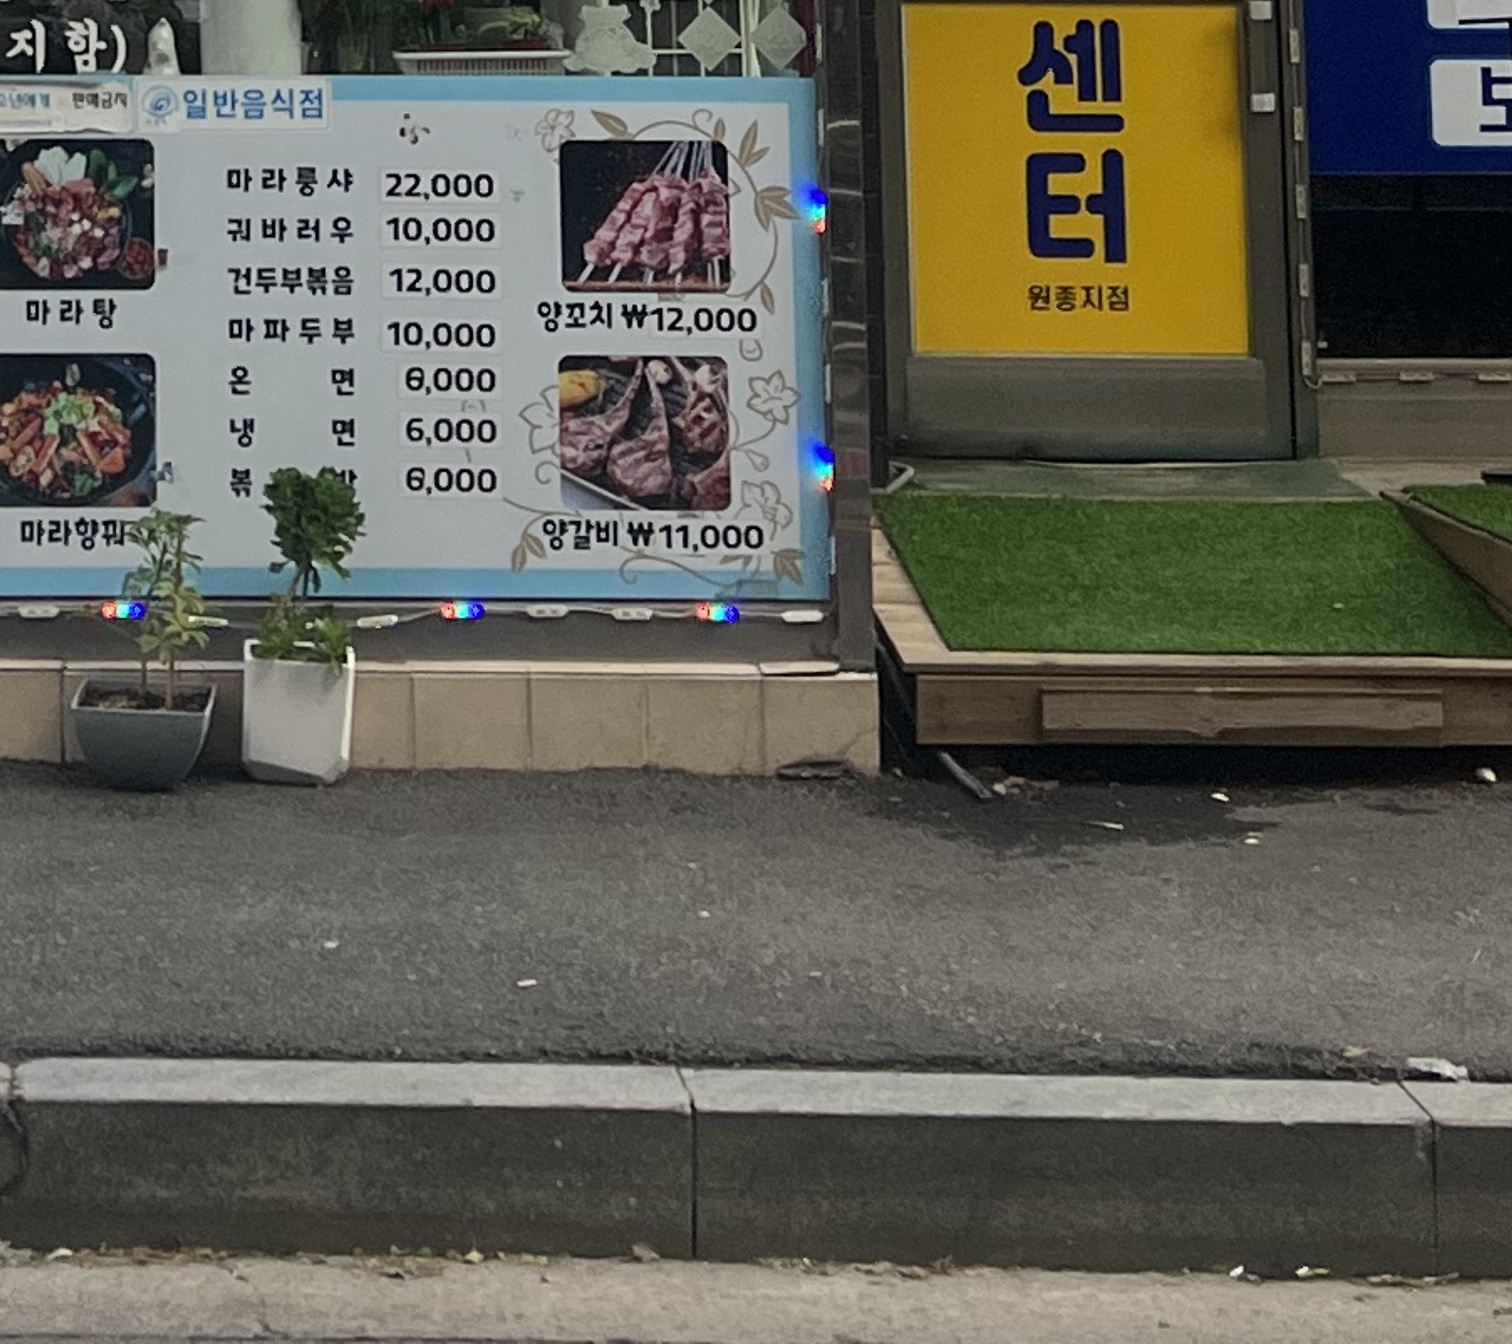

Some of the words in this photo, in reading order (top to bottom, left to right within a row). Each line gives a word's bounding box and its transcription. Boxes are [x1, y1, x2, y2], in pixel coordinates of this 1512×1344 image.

[182, 87, 325, 120] 일반음식점
[1017, 18, 1128, 264] 센터
[385, 173, 495, 200] 22,000
[385, 216, 496, 245] 10,000
[227, 265, 354, 296] 건두부볶음
[388, 268, 497, 296] 12,000
[26, 298, 117, 329] 마라탕
[1027, 284, 1130, 312] 원종지점
[536, 300, 614, 332] 양꼬치
[228, 317, 356, 345] 마파두부
[386, 322, 497, 350] 10,000
[404, 367, 497, 395] 6,000
[405, 417, 498, 446] 6,000
[405, 467, 498, 496] 6,000
[541, 517, 619, 552] 양갈비
